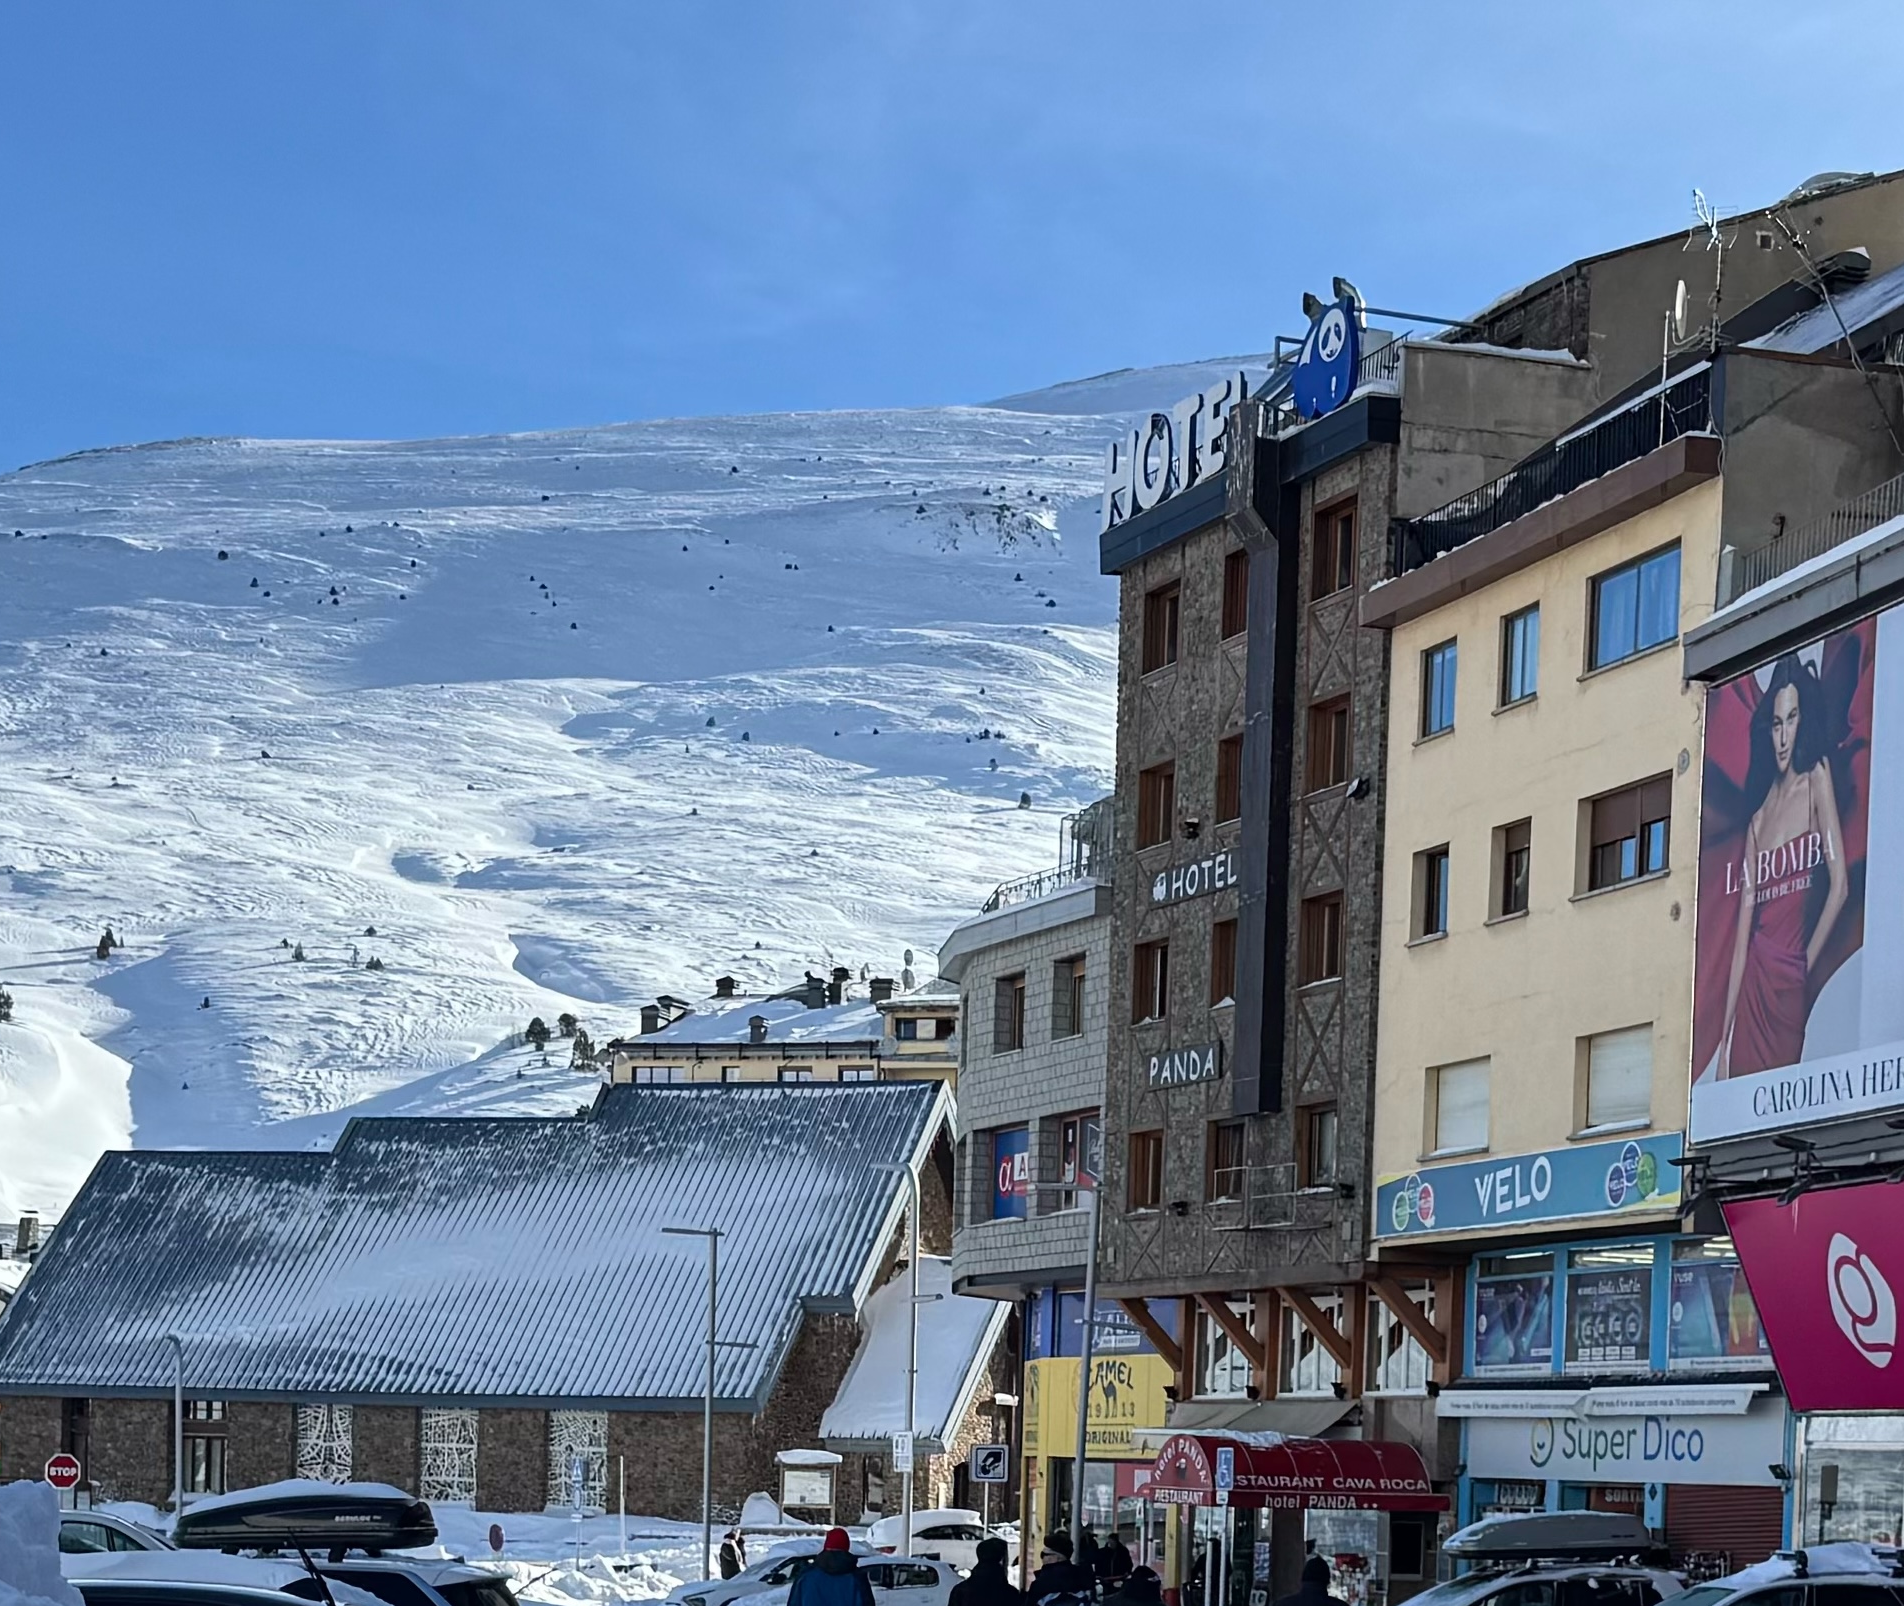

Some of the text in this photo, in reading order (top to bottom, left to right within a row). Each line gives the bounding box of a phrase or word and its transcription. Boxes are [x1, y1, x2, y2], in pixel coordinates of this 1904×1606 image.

[1170, 853, 1238, 900] HOTEL
[1725, 858, 1751, 895] LA
[1756, 828, 1836, 885] BOMBA
[1149, 1048, 1215, 1086] PANDA
[1753, 1068, 1854, 1118] CAROLINA
[1474, 1156, 1553, 1217] VELO
[1561, 1416, 1704, 1471] Super Dico
[49, 1466, 77, 1477] STOP
[1235, 1474, 1428, 1491] STAURANT CAVA ROCA
[1265, 1495, 1357, 1509] hotel PANDA
